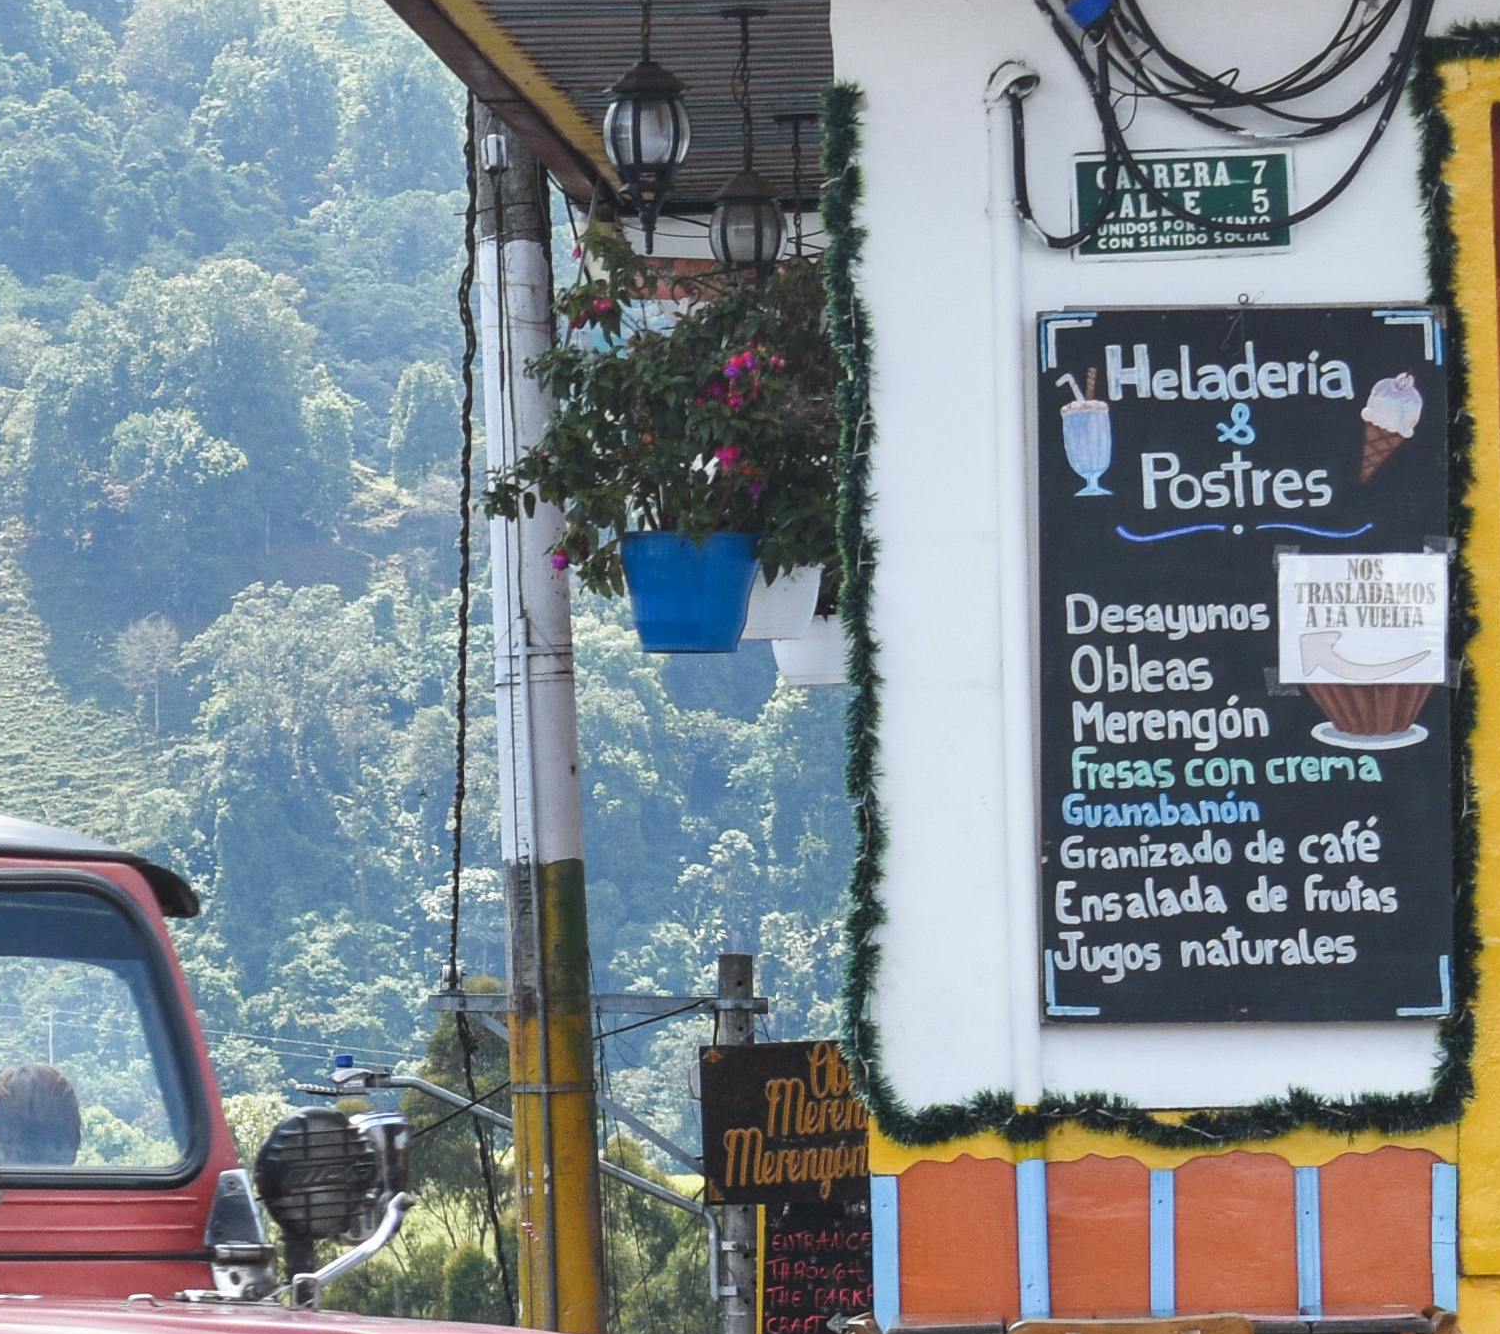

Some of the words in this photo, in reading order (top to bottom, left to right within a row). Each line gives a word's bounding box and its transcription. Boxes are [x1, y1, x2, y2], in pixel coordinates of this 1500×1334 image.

[1252, 160, 1267, 185] 7
[1252, 188, 1270, 214] 5
[1097, 236, 1135, 249] CON
[1140, 232, 1208, 247] SENTIDO
[1215, 403, 1256, 445] &
[1140, 451, 1333, 510] Postres
[1347, 558, 1384, 581] NOS
[1294, 582, 1437, 605] TRASLADAMOS
[1065, 593, 1271, 640] Desayunos
[1305, 606, 1318, 628] A
[1325, 605, 1348, 628] LA
[1355, 605, 1424, 628] VUELTA
[1070, 644, 1214, 694] Obleas
[1072, 695, 1269, 752] Merengón
[1184, 757, 1255, 787] con
[1265, 754, 1383, 784] crema
[1061, 791, 1260, 827] Guanabanón
[1060, 829, 1232, 869] Granizado
[1245, 829, 1286, 864] de
[1299, 816, 1381, 863] café
[1055, 875, 1228, 924] Ensalada
[1246, 875, 1288, 913] de
[1303, 873, 1398, 914] frutas
[1054, 931, 1161, 984] Jugos
[1180, 926, 1357, 967] naturales
[766, 1286, 802, 1308] THE
